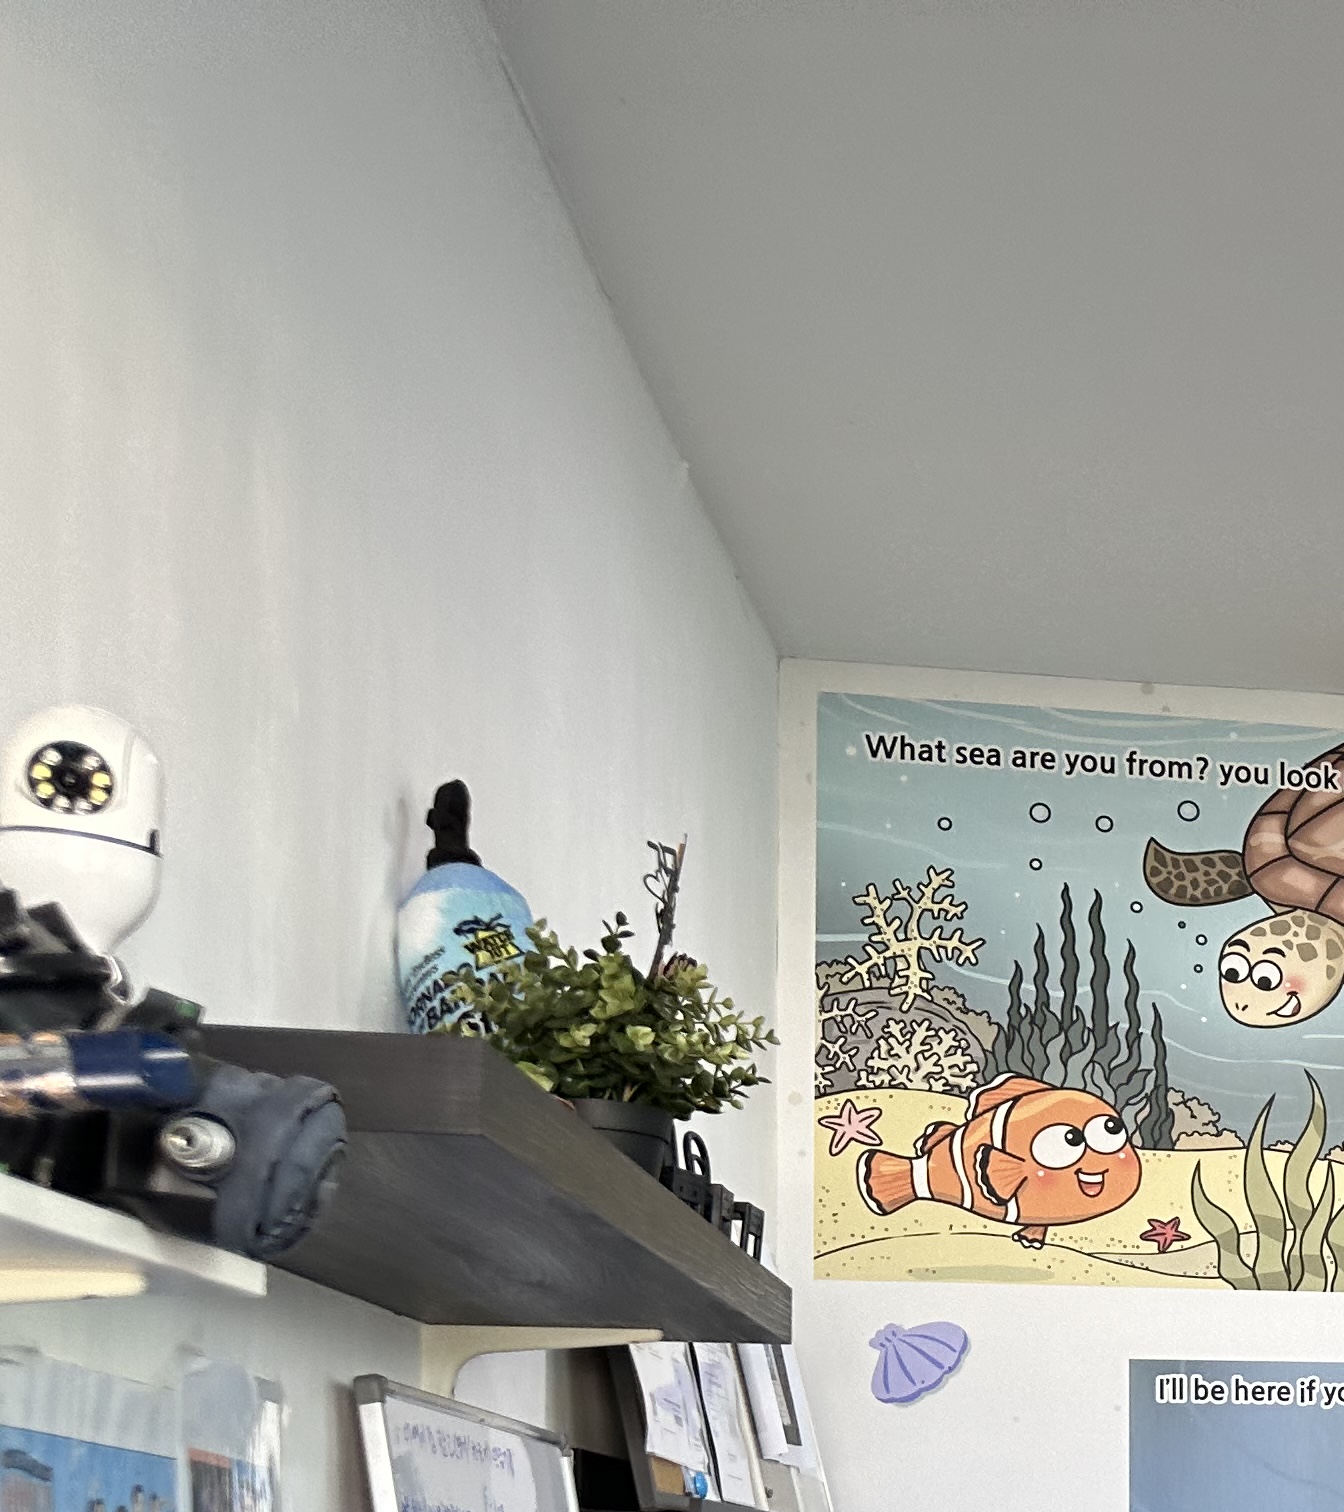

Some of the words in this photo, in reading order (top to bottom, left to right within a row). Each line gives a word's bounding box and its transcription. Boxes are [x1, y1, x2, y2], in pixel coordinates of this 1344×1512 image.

[865, 733, 947, 763] What
[955, 746, 1001, 767] sea
[1011, 749, 1056, 770] are
[1064, 753, 1115, 776] you
[1125, 750, 1209, 781] from?
[1219, 764, 1269, 786] you
[1279, 760, 1337, 790] look
[1159, 1377, 1184, 1400] I'll
[1194, 1377, 1225, 1401] be
[1235, 1378, 1291, 1402] here
[1300, 1379, 1316, 1403] if
